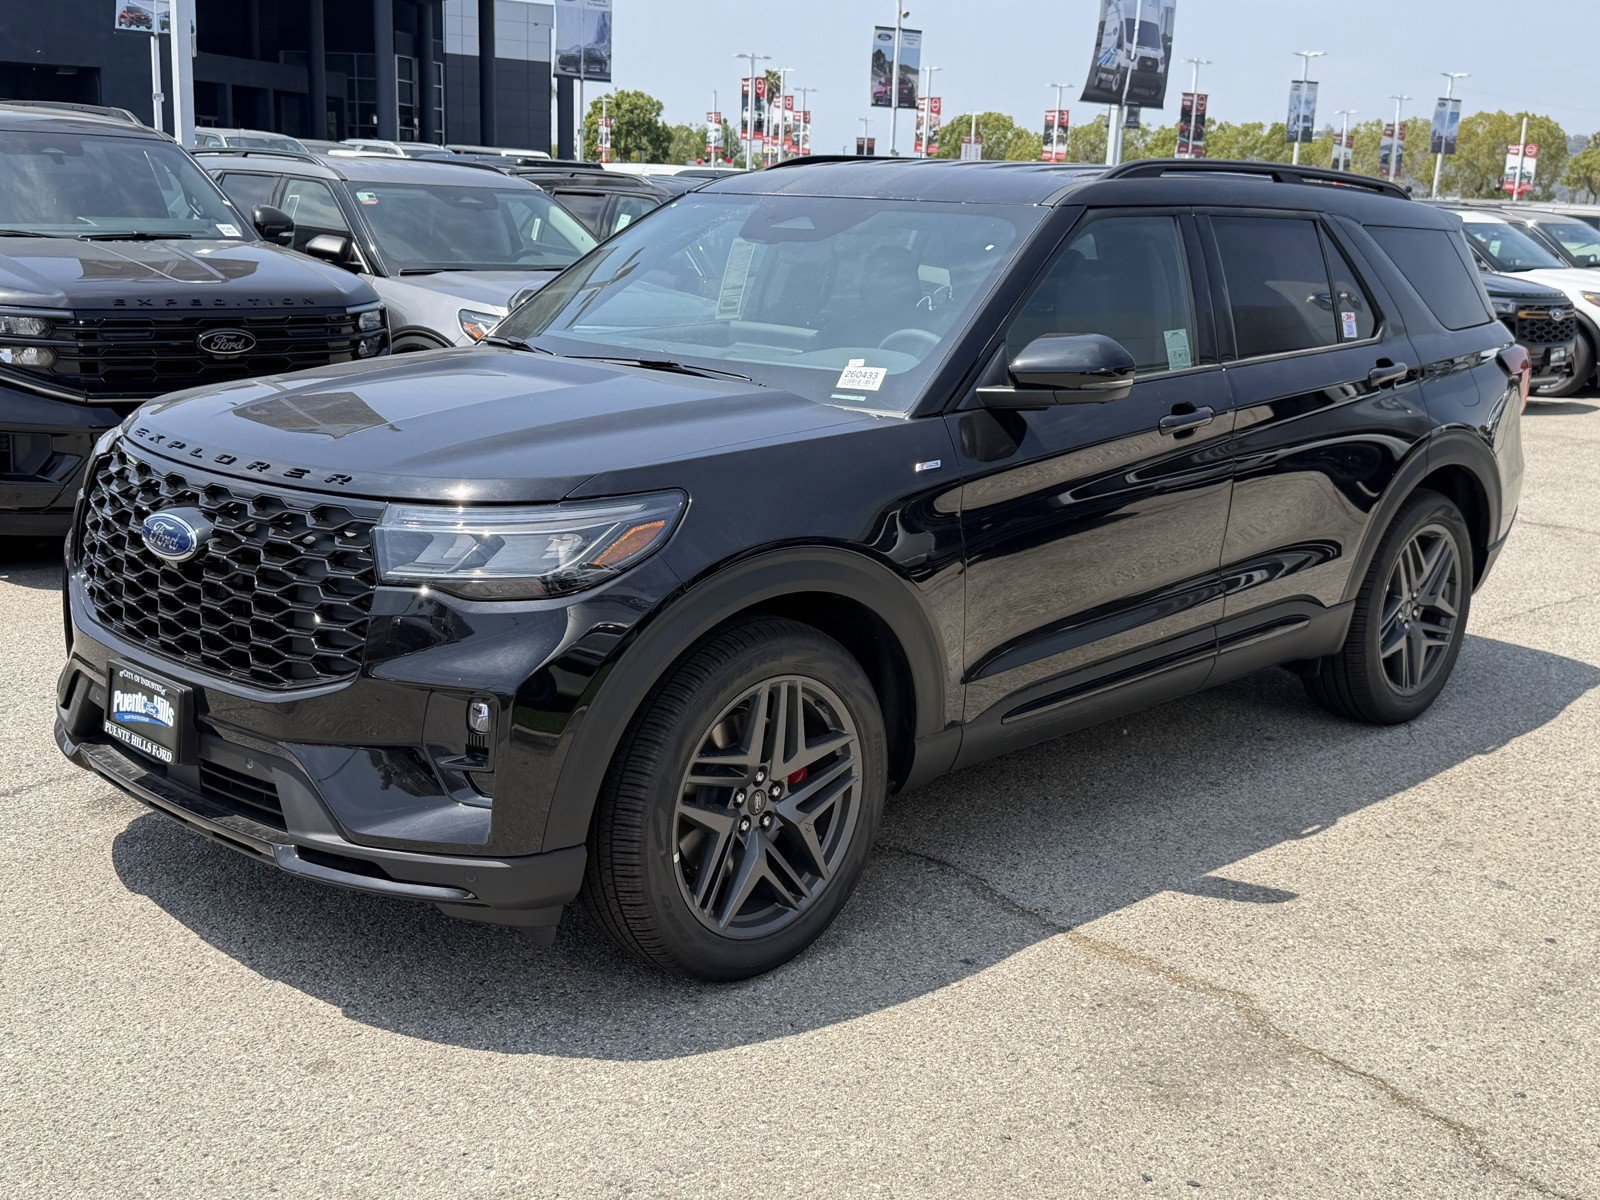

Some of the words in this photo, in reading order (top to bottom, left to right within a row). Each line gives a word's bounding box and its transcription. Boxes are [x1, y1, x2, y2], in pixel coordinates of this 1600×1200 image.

[113, 297, 315, 307] EXPEDITION
[210, 334, 245, 352] Ford
[844, 370, 879, 380] 260433
[134, 427, 353, 486] EXPLORER
[148, 520, 179, 551] Ford
[123, 669, 133, 680] CITY
[134, 674, 140, 682] OF
[154, 694, 174, 727] Hills
[105, 722, 131, 743] PUENTE
[131, 733, 152, 752] HILLS
[152, 745, 172, 763] FORD
